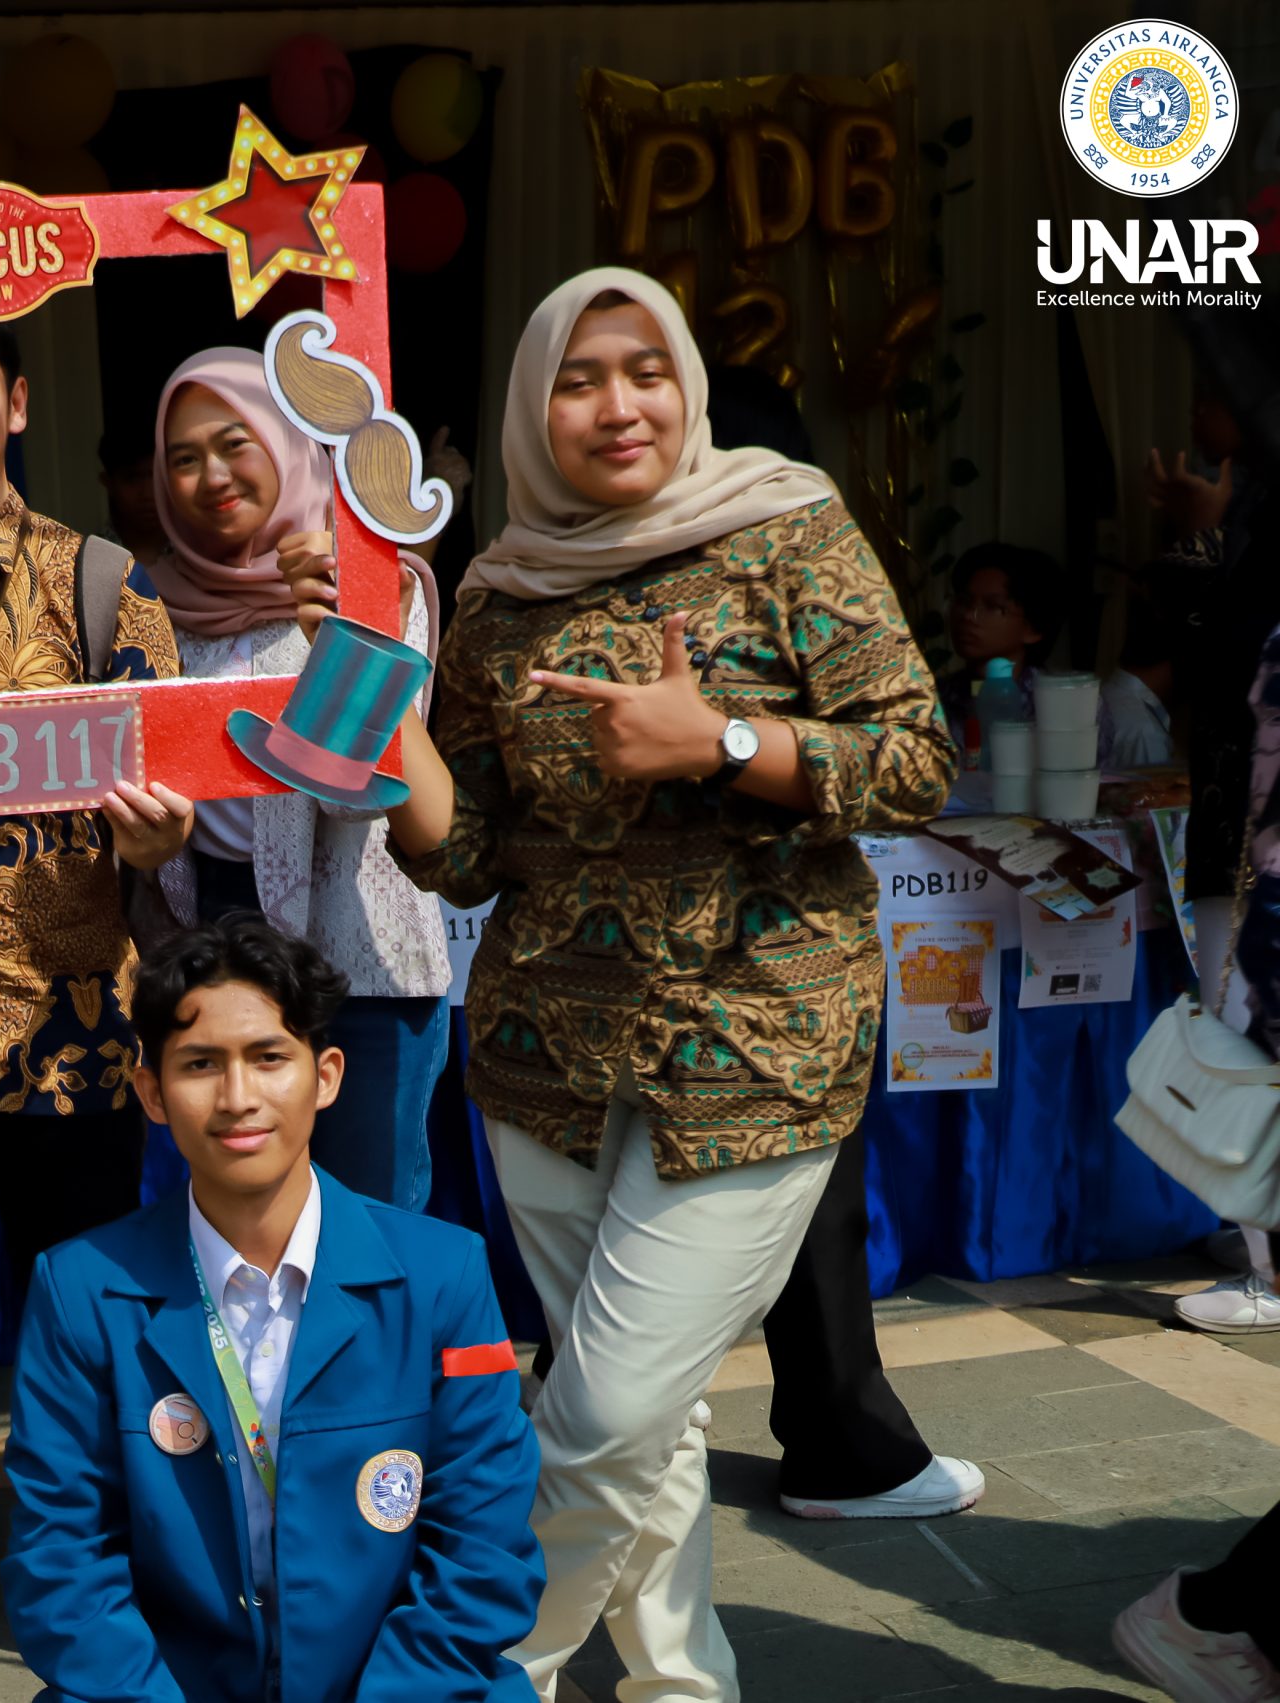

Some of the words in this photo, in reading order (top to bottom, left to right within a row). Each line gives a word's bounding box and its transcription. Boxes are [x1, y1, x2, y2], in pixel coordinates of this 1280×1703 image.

[620, 114, 899, 256] PDB
[9, 204, 26, 221] THE
[892, 868, 988, 898] PDB119
[204, 1302, 229, 1350] 2025
